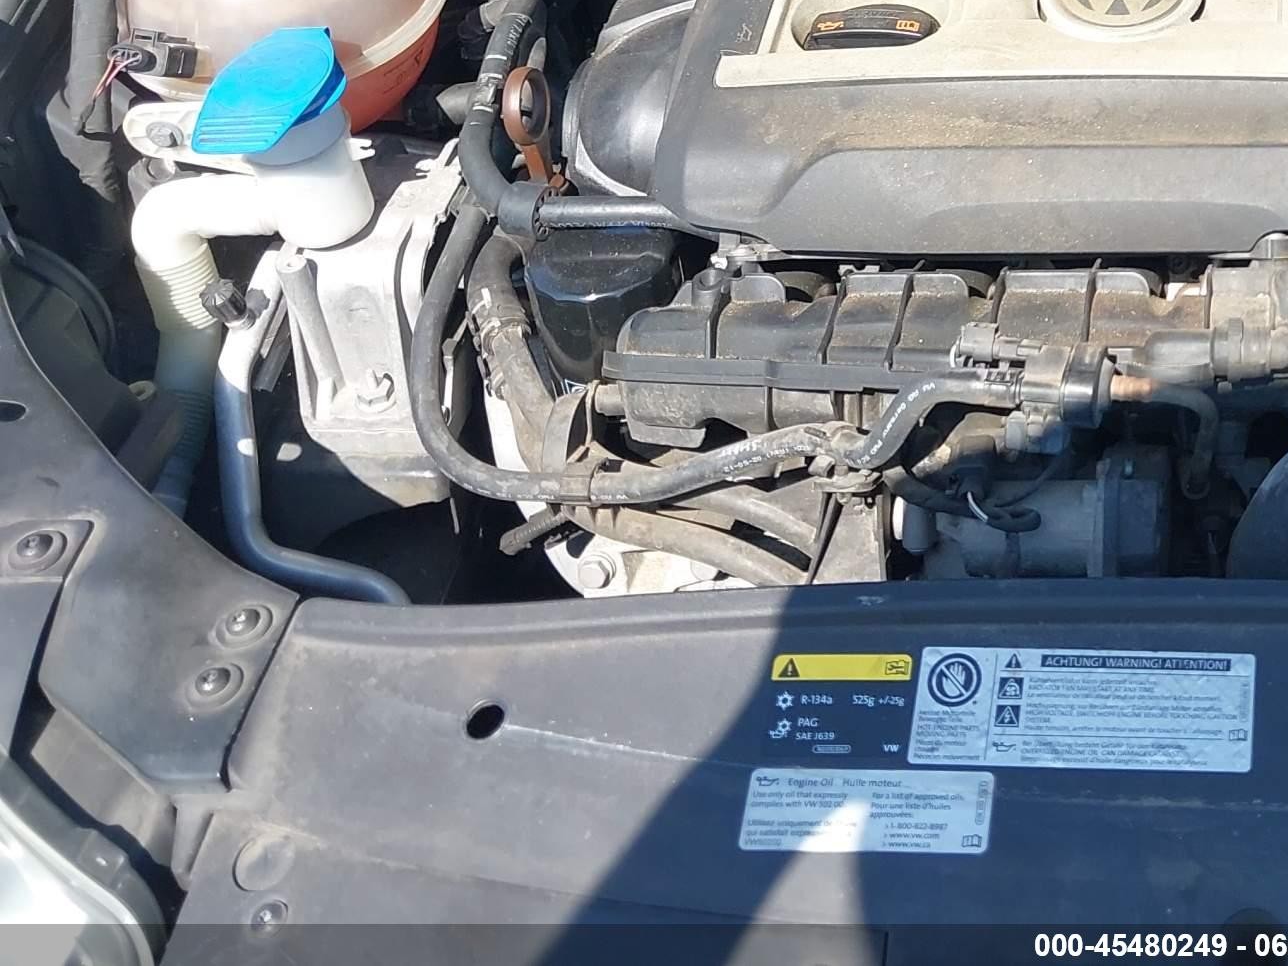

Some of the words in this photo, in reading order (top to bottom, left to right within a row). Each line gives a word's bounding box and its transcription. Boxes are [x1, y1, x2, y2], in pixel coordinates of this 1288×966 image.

[1045, 656, 1103, 667] ACHTUNG!
[1105, 658, 1162, 669] WARNING!
[1164, 659, 1228, 671] ATTENTION!
[801, 694, 833, 705] R-134a
[852, 694, 876, 707] 525g
[797, 717, 819, 727] PAG
[795, 732, 813, 740] SAE
[814, 732, 835, 740] J639
[883, 744, 900, 753] VW
[788, 778, 818, 788] Engine
[820, 778, 833, 787] Oil
[868, 780, 902, 788] moteur
